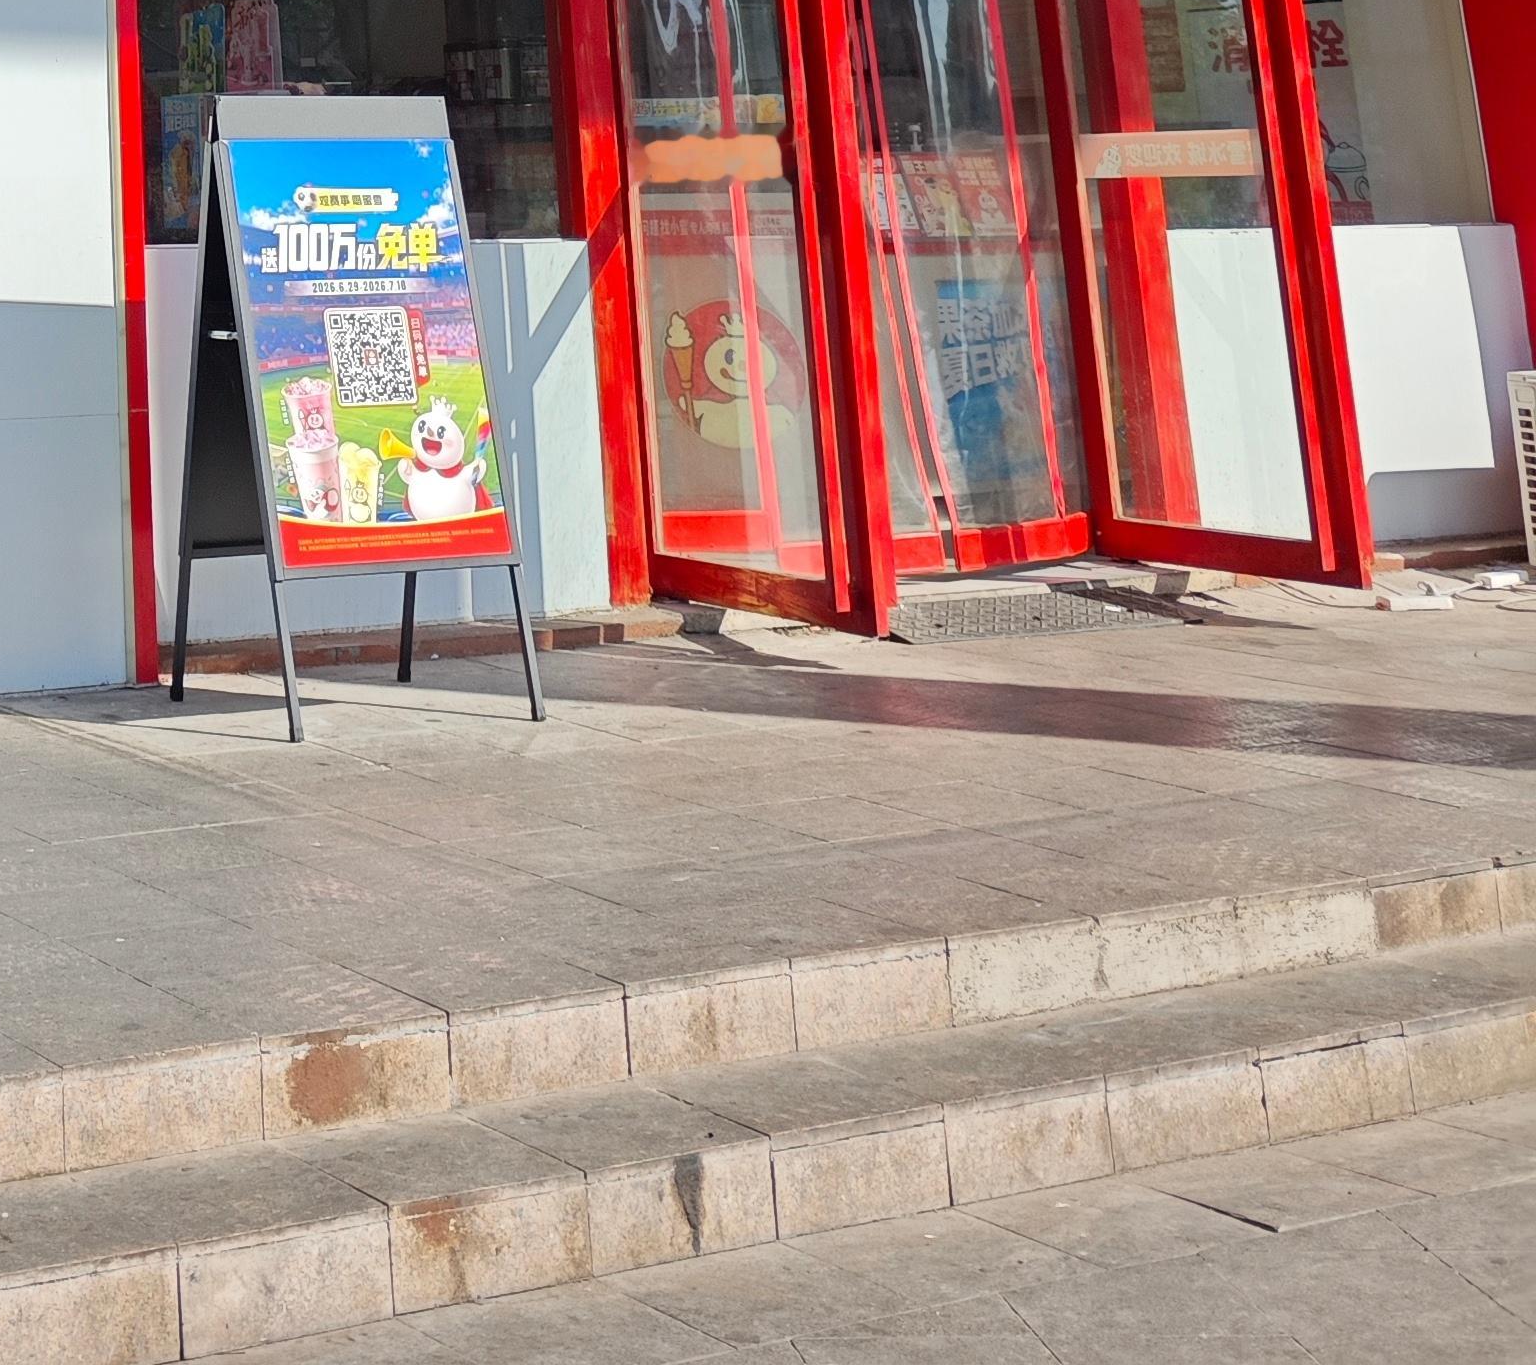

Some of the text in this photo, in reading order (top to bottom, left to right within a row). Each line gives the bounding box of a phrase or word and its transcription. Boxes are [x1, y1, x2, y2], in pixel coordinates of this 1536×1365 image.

[261, 221, 440, 274] 送100万份免单
